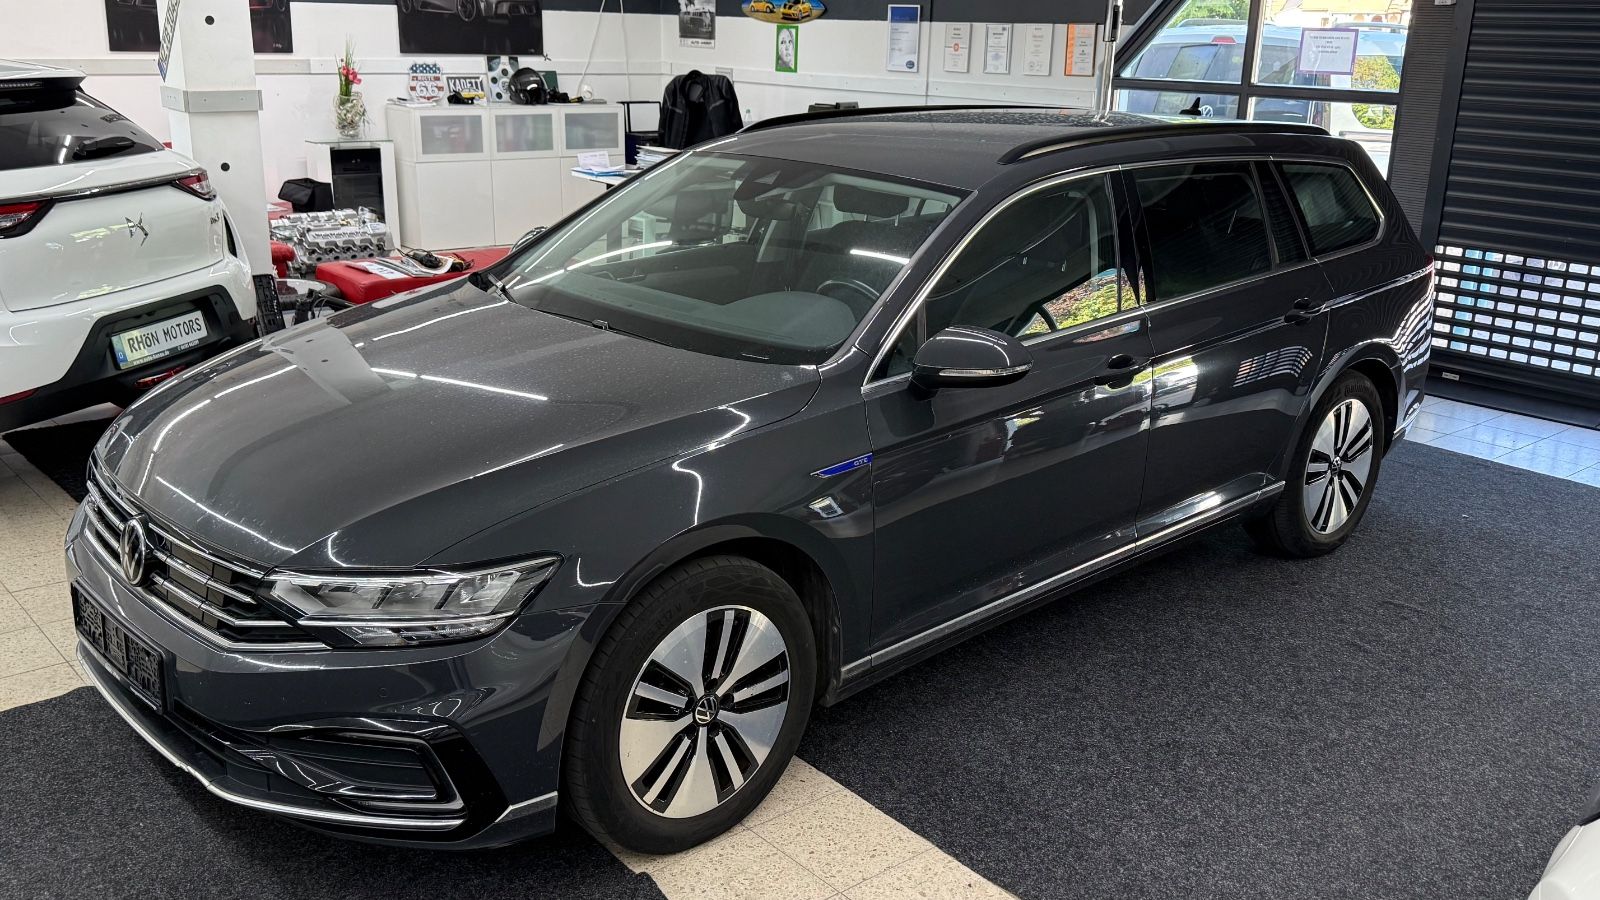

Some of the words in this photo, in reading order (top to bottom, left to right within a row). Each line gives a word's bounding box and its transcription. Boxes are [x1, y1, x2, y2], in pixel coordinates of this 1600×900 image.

[416, 81, 440, 97] 66
[162, 317, 202, 342] MOTORS
[853, 457, 868, 466] GTE
